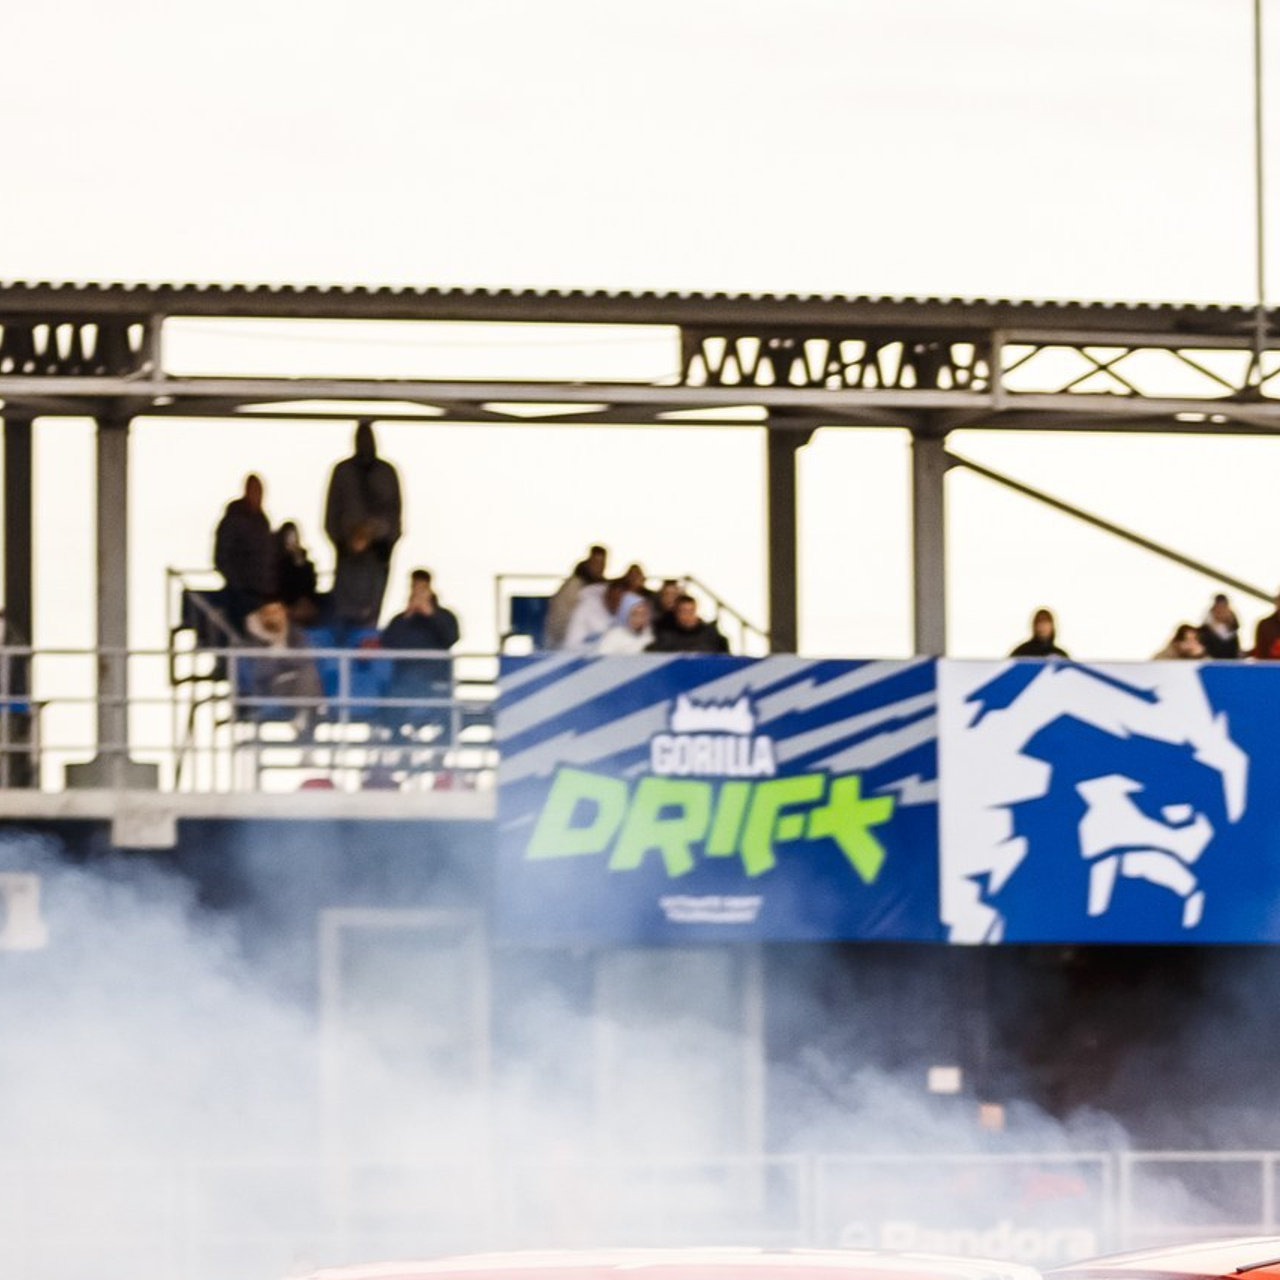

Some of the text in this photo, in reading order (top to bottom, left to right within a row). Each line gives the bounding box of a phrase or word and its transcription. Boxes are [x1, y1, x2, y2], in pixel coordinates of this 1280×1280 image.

[650, 735, 776, 777] GORILLA
[525, 767, 896, 884] DRIFT
[880, 1220, 1097, 1260] Pandora
